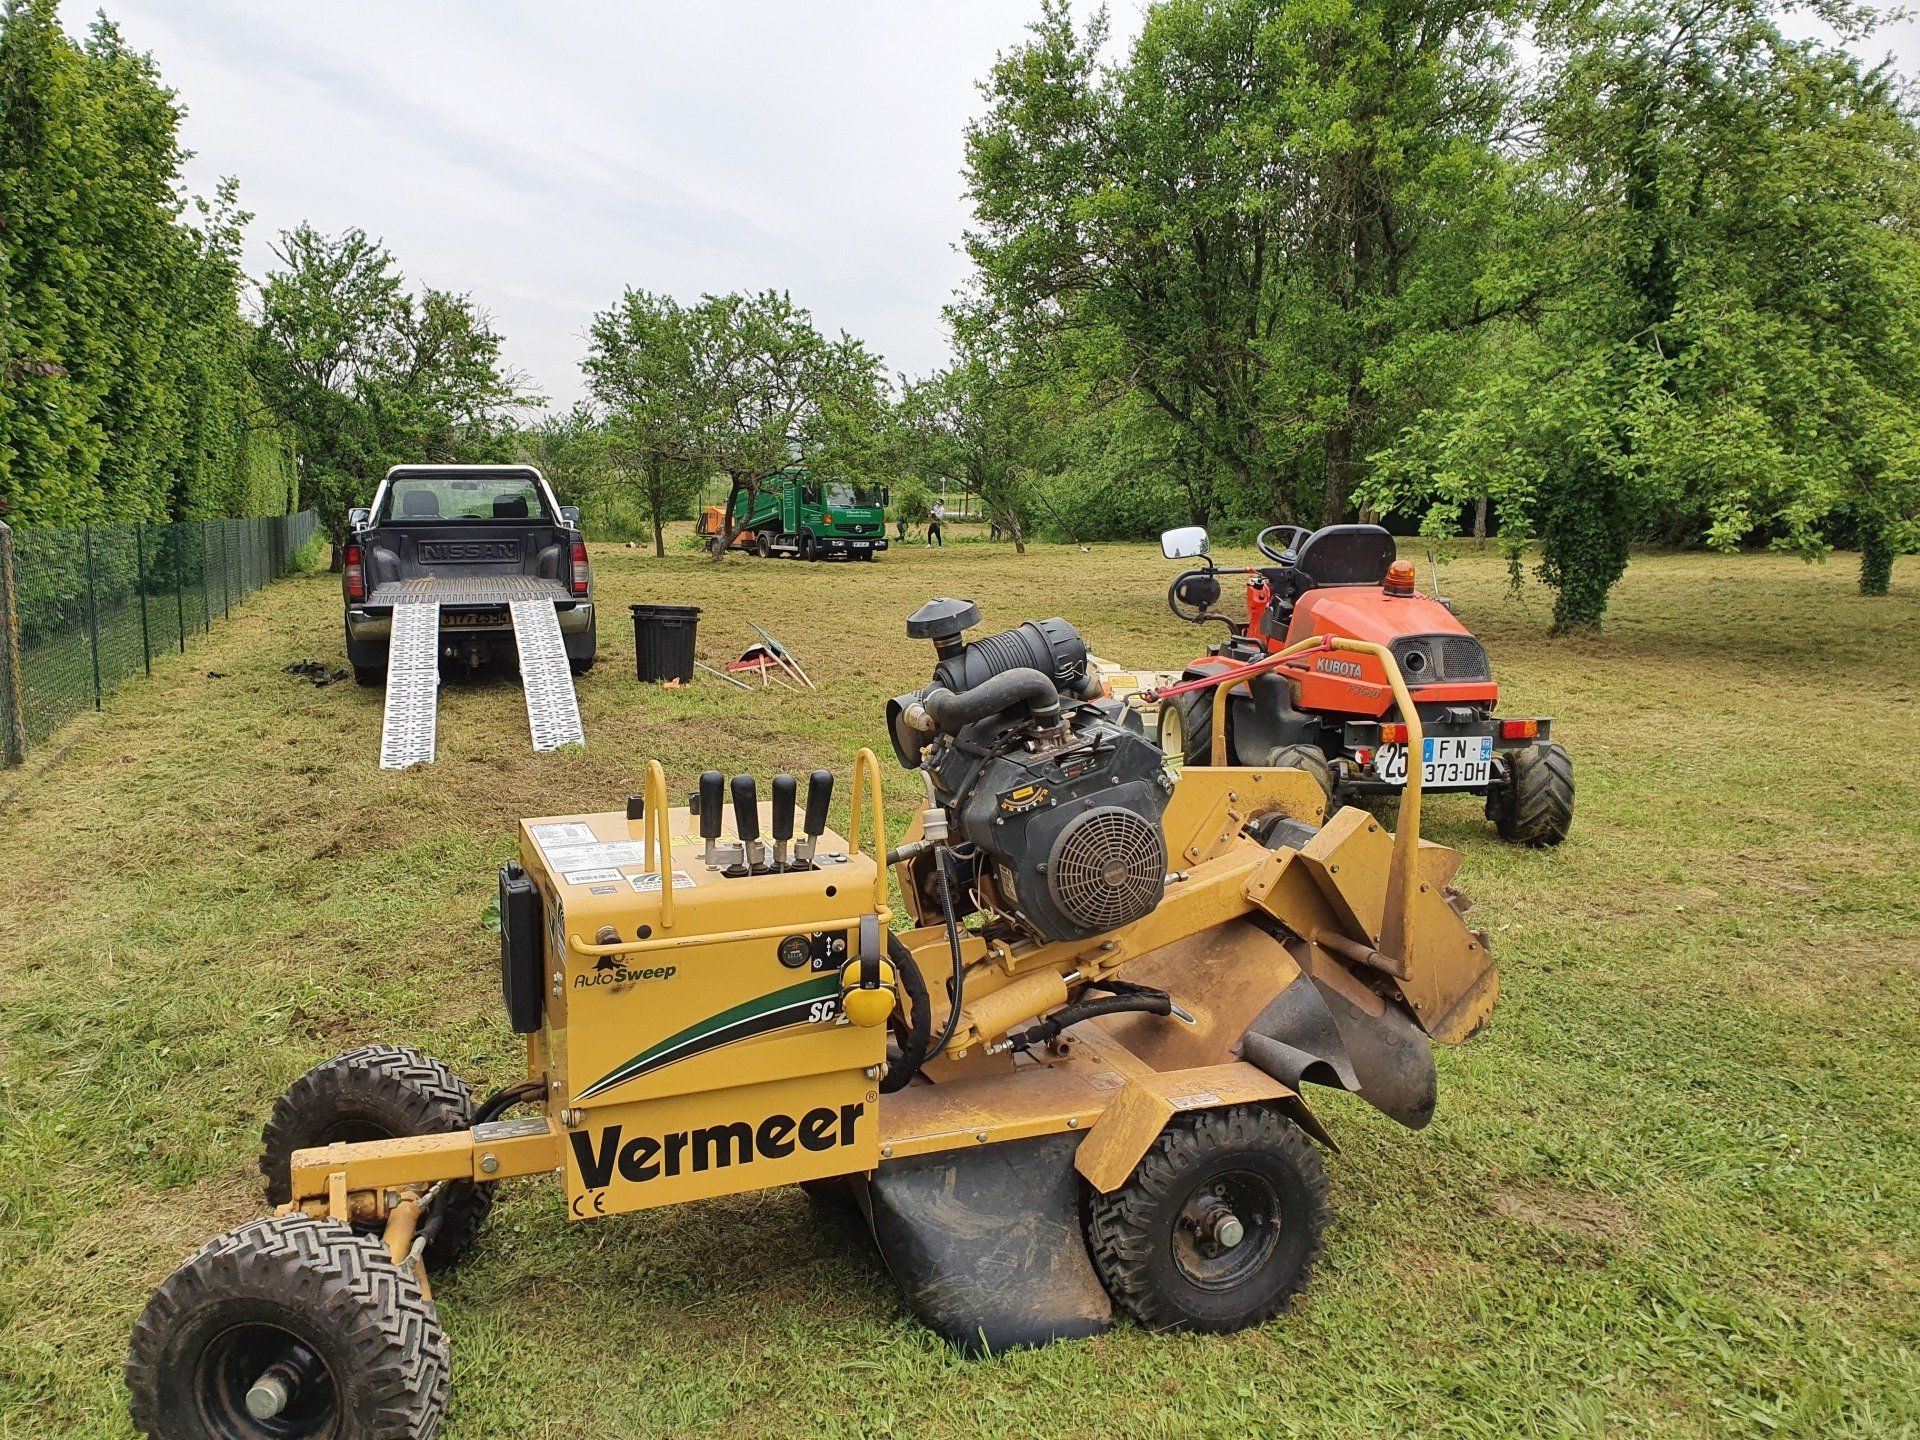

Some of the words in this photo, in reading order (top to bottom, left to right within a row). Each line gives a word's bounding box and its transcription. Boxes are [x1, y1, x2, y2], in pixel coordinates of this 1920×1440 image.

[424, 543, 514, 559] NISSAN
[1317, 657, 1363, 679] KUBOTA
[1385, 742, 1409, 778] 25
[1481, 749, 1490, 759] 54
[574, 965, 677, 989] AutoSweep
[808, 1001, 836, 1023] SC
[569, 1102, 864, 1189] Vermeer
